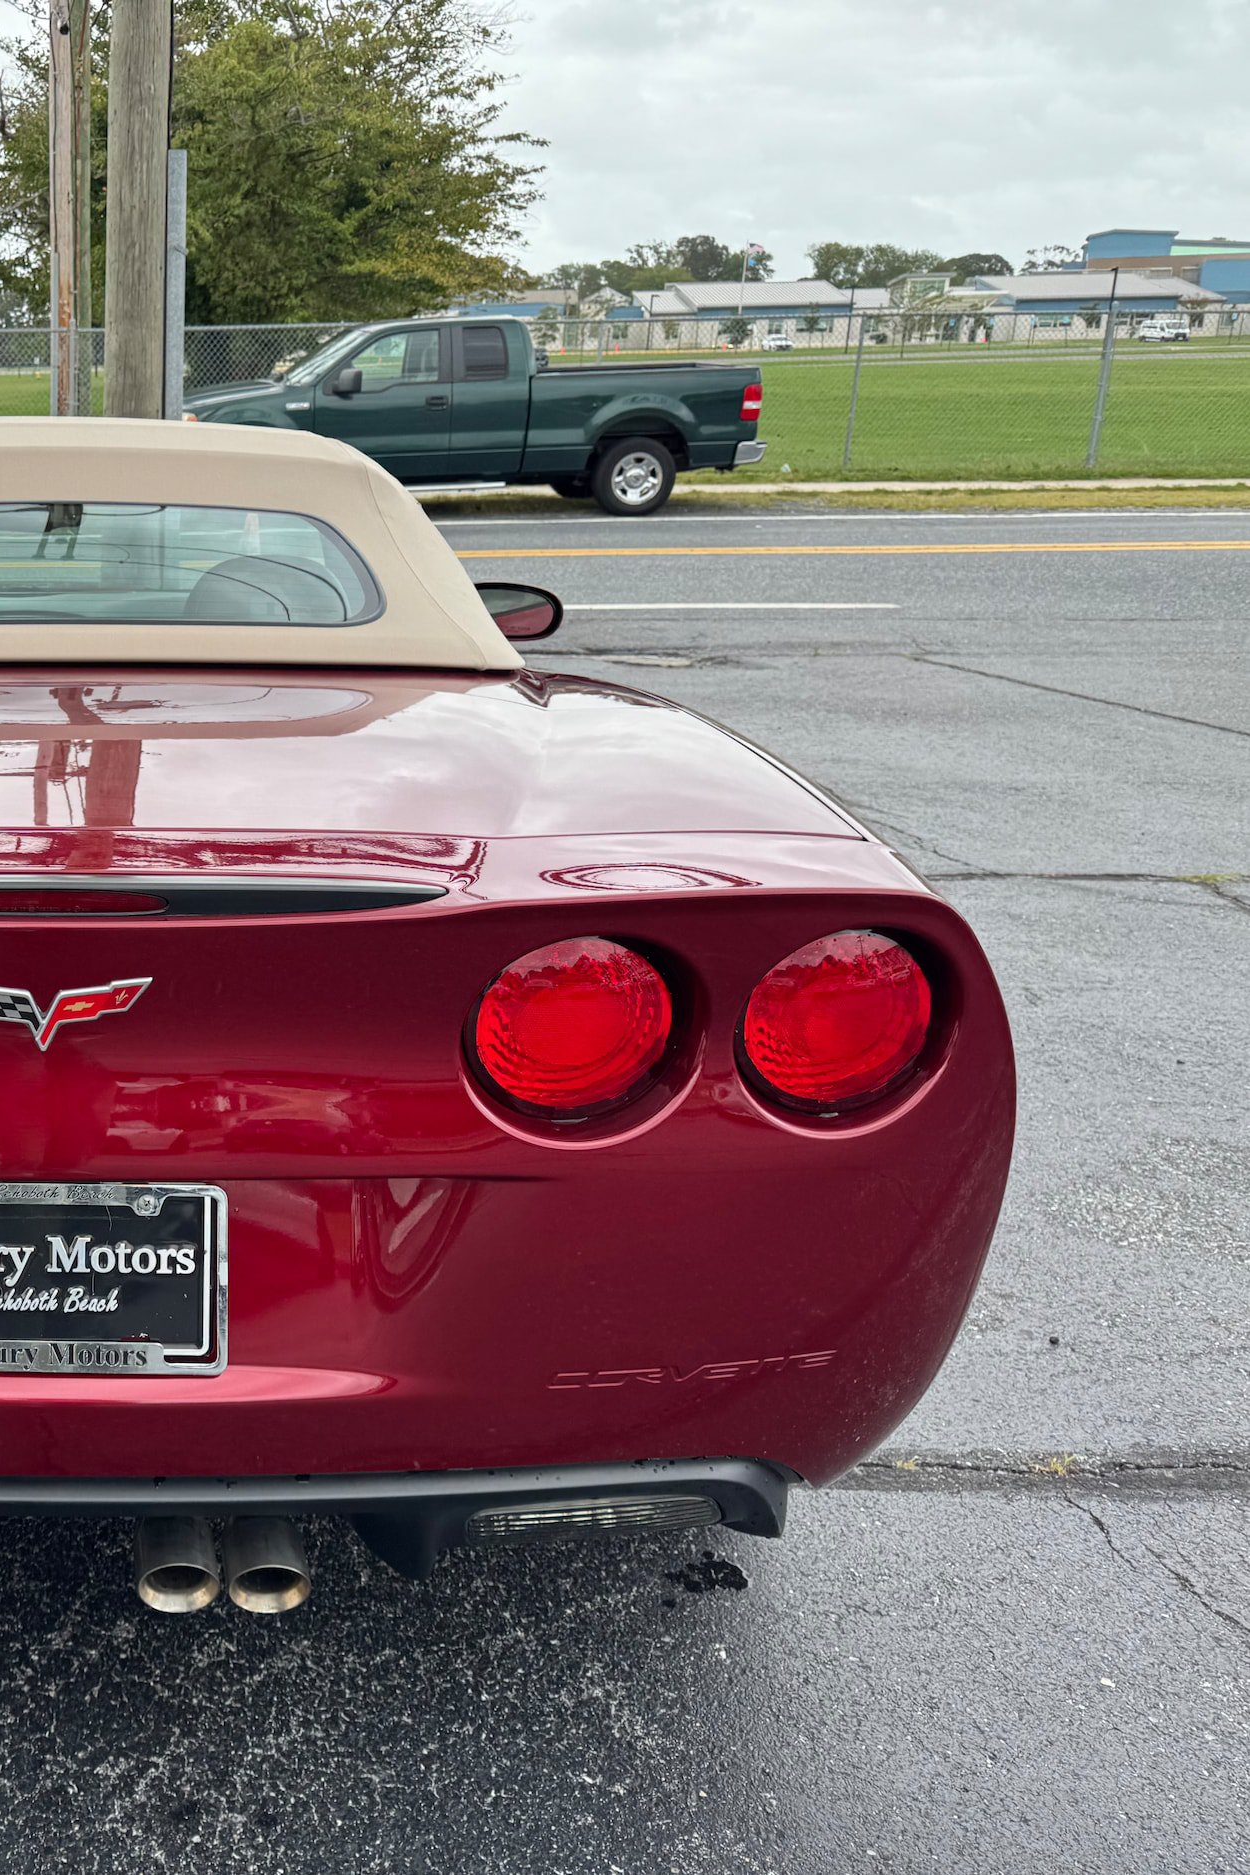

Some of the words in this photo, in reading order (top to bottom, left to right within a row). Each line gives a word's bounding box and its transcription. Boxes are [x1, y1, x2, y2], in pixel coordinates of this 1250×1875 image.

[67, 1185, 115, 1200] Beach
[45, 1235, 197, 1276] Motors
[63, 1286, 120, 1313] Beach
[47, 1342, 149, 1367] Motors
[547, 1349, 839, 1389] CORVETTE
